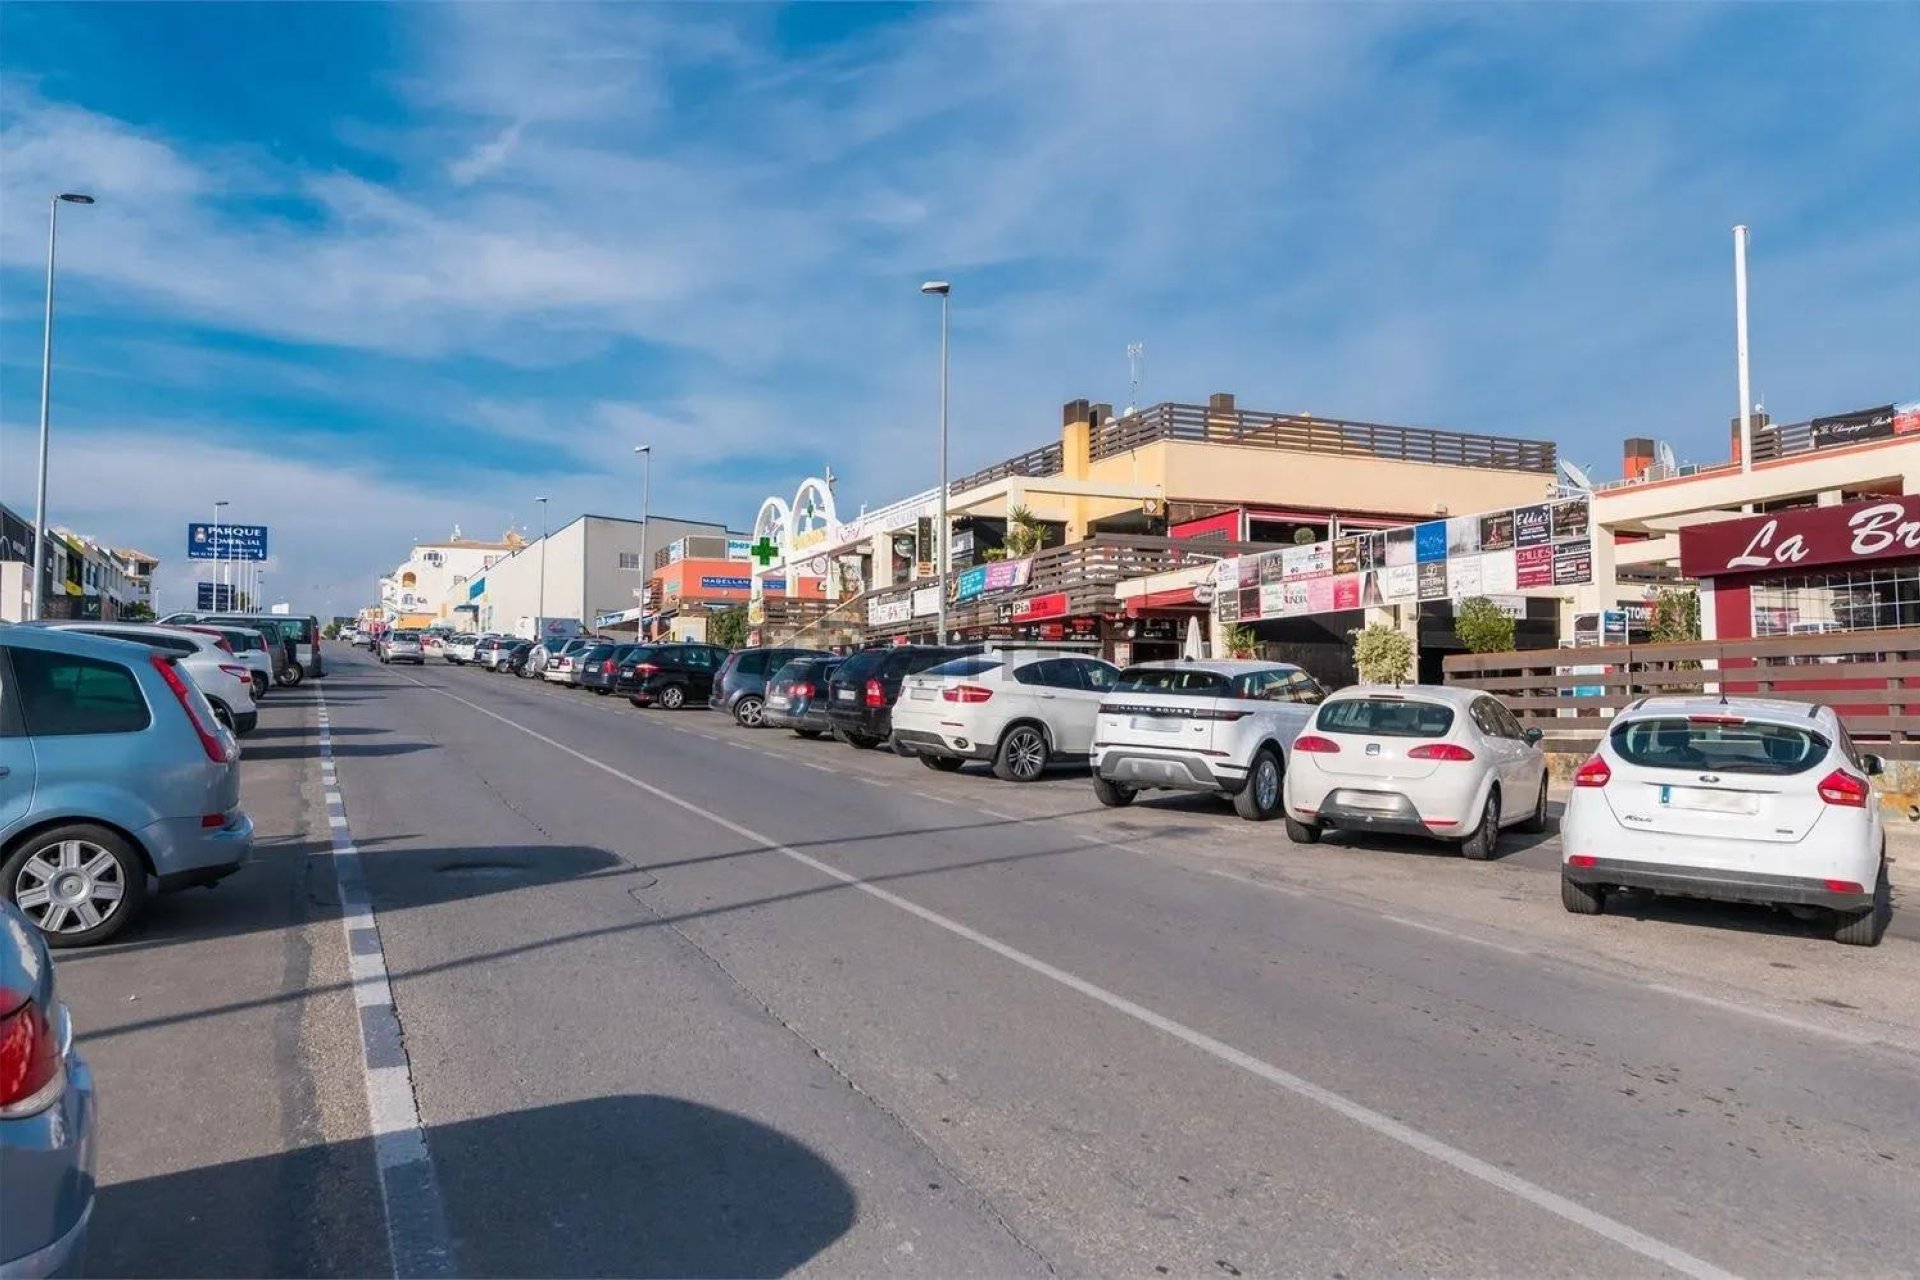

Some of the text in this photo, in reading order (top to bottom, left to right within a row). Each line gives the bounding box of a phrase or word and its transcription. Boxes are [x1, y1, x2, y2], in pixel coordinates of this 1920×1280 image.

[207, 527, 262, 537] PARQUE
[207, 537, 261, 546] COMERCIAL
[1727, 520, 1809, 569] La
[1155, 707, 1191, 715] ROVER
